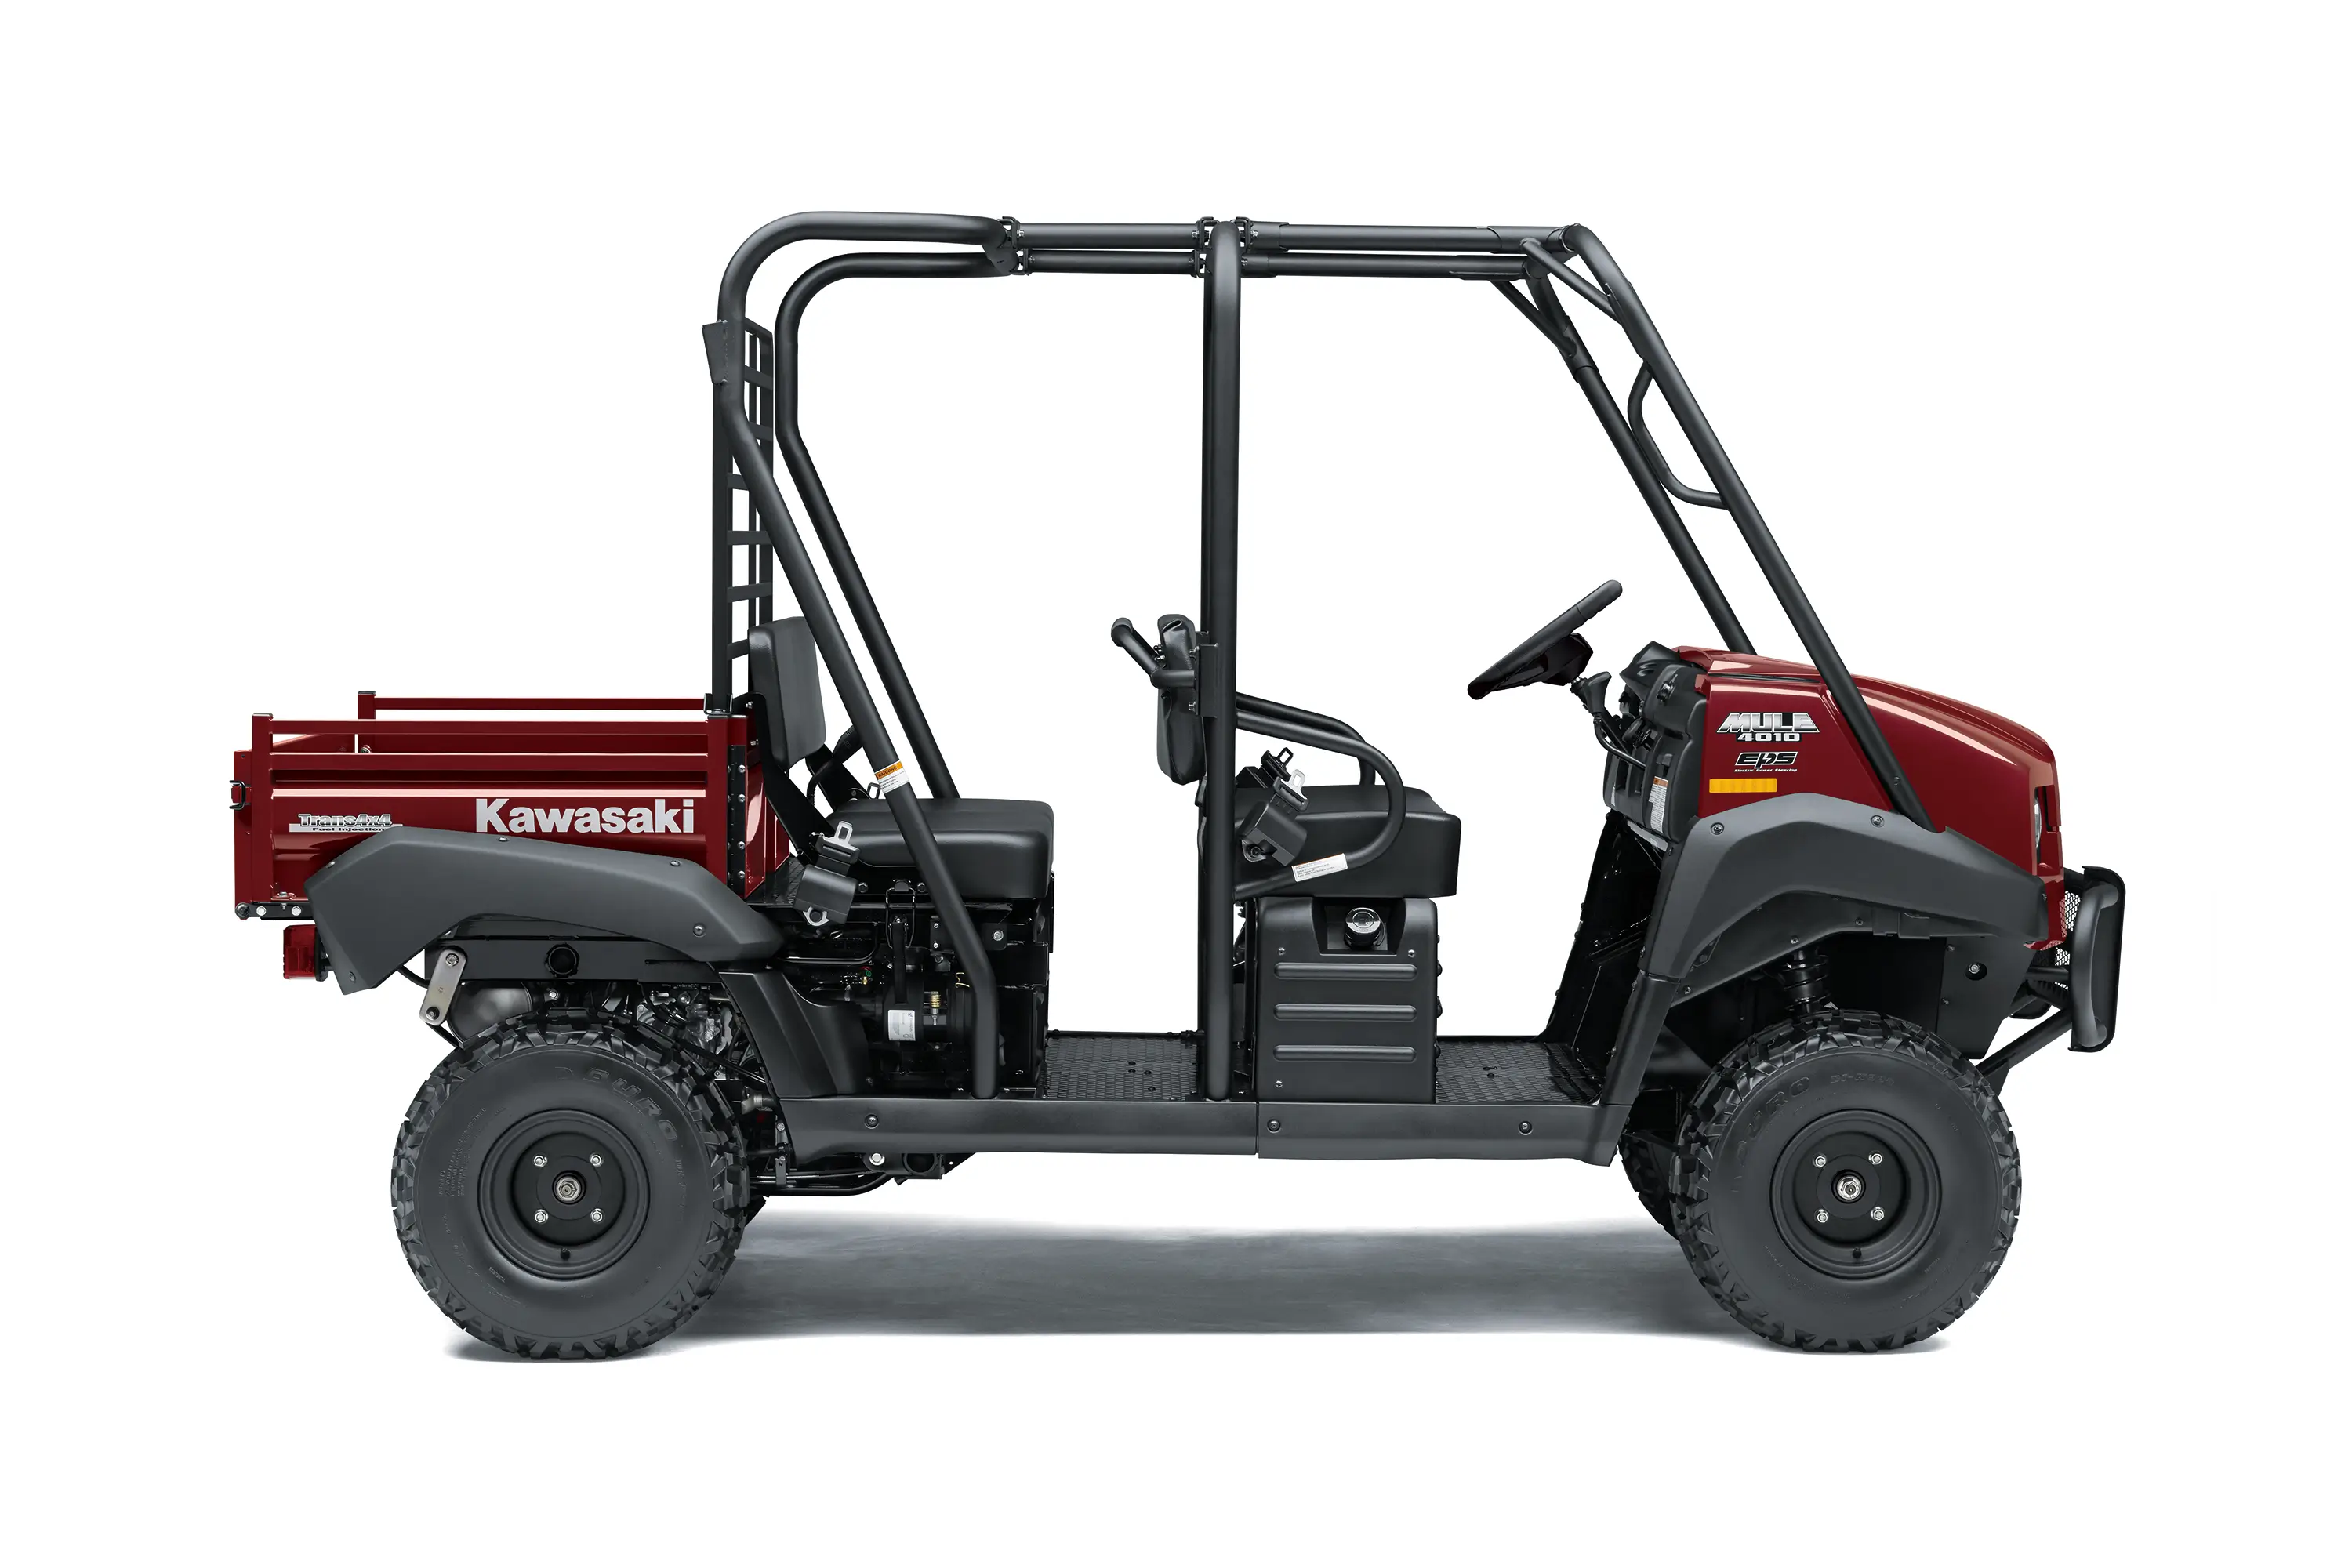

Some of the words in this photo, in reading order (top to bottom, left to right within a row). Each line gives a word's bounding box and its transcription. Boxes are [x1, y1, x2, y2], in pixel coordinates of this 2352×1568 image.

[1717, 713, 1820, 732] MULE
[1737, 733, 1800, 742] 4010
[298, 814, 392, 826] Trans4x4
[476, 798, 694, 833] Kawasaki
[583, 1068, 678, 1141] DURO
